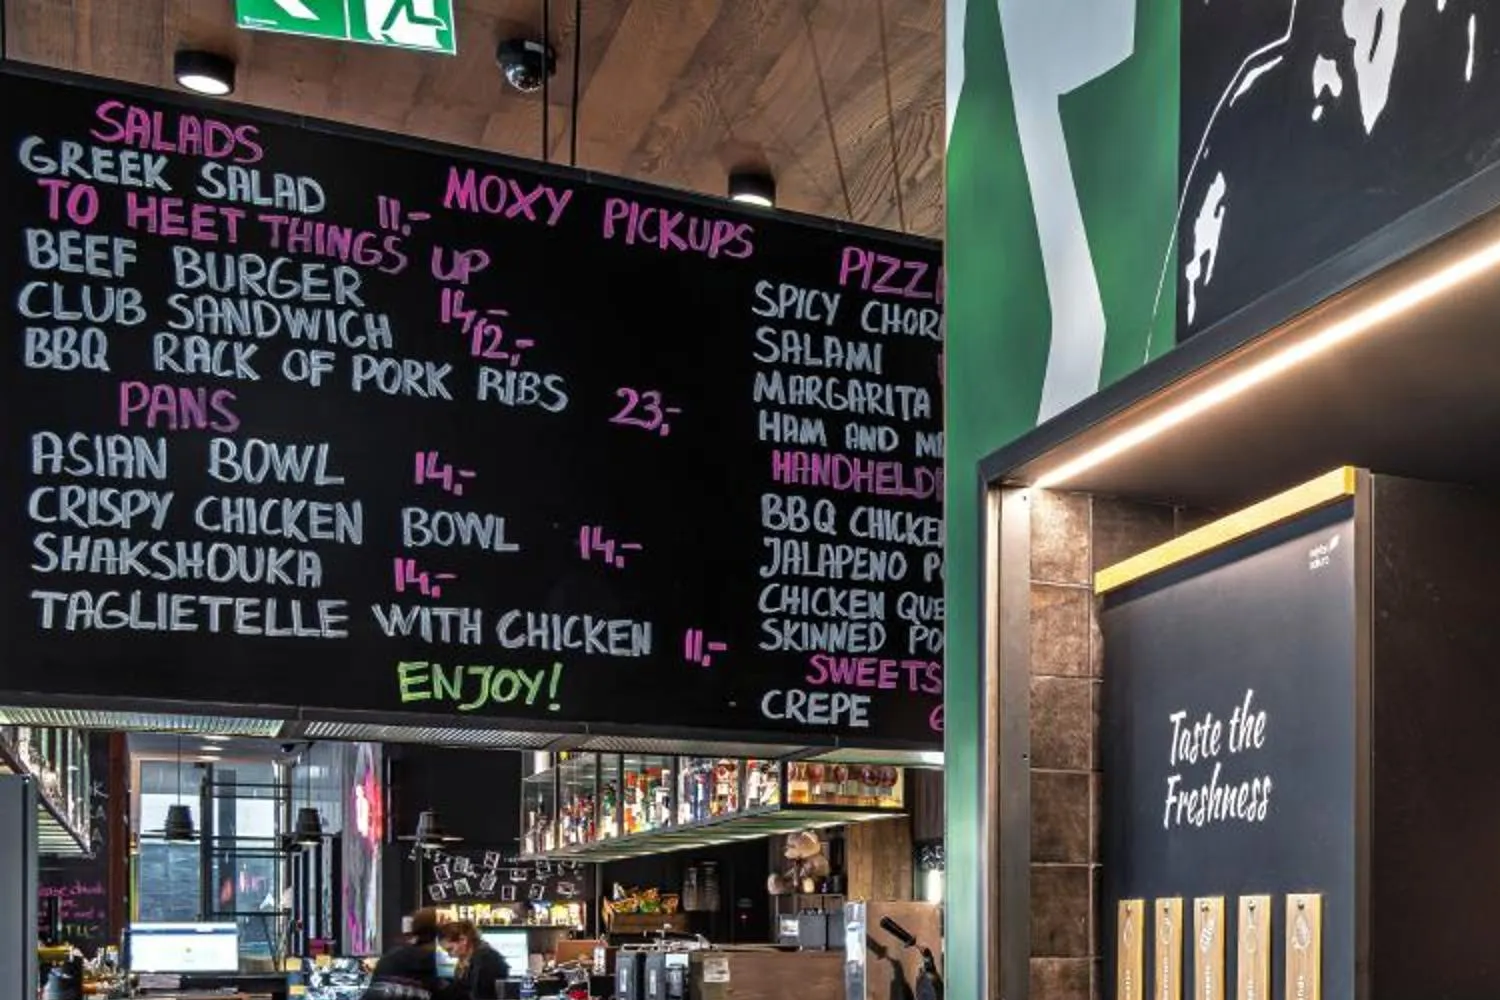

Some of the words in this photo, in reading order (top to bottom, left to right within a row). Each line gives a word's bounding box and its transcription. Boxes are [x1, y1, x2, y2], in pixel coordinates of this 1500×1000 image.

[89, 100, 264, 164] SALADS
[18, 135, 172, 192] GREEK
[196, 162, 326, 214] SALAD
[36, 178, 99, 225] TO
[258, 214, 408, 275] THINGS
[431, 243, 491, 285] UP
[444, 166, 573, 227] MOXY
[603, 198, 755, 259] PICKUPS
[24, 229, 138, 279] BEEF
[172, 245, 365, 307] BURGER
[17, 282, 148, 326] CLUB
[168, 293, 394, 350] SANDWICH
[751, 280, 842, 326] SPICY
[24, 326, 111, 372] BBQ
[153, 331, 260, 382] RACK
[282, 349, 336, 387] OF
[351, 354, 454, 401] PORK
[476, 364, 568, 413] RIBS
[753, 325, 884, 375] SALAMI
[119, 381, 241, 433] PANS
[753, 369, 932, 421] MARGARITA
[759, 409, 828, 447] HAM
[845, 421, 899, 452] AND
[31, 431, 167, 480] ASIAN
[208, 437, 345, 486] BOWL
[28, 486, 174, 531] CRISPY
[194, 495, 364, 545] CHICKEN
[402, 507, 520, 553] BOWL
[760, 493, 837, 536] BBQ
[31, 532, 323, 588] SHAKSHOUKA
[759, 537, 907, 581] JALAPENO
[30, 590, 348, 639] TAGLIETELLE
[371, 603, 482, 645] WITH
[498, 609, 653, 657] CHICKEN
[757, 583, 885, 620] CHICKEN
[758, 617, 886, 653] SKINNED
[397, 661, 564, 711] ENJOY!
[806, 653, 943, 694] SWEETS
[761, 689, 871, 727] CREPE
[1169, 709, 1221, 767] Taste
[1228, 688, 1267, 754] the
[1163, 761, 1272, 830] Freshness
